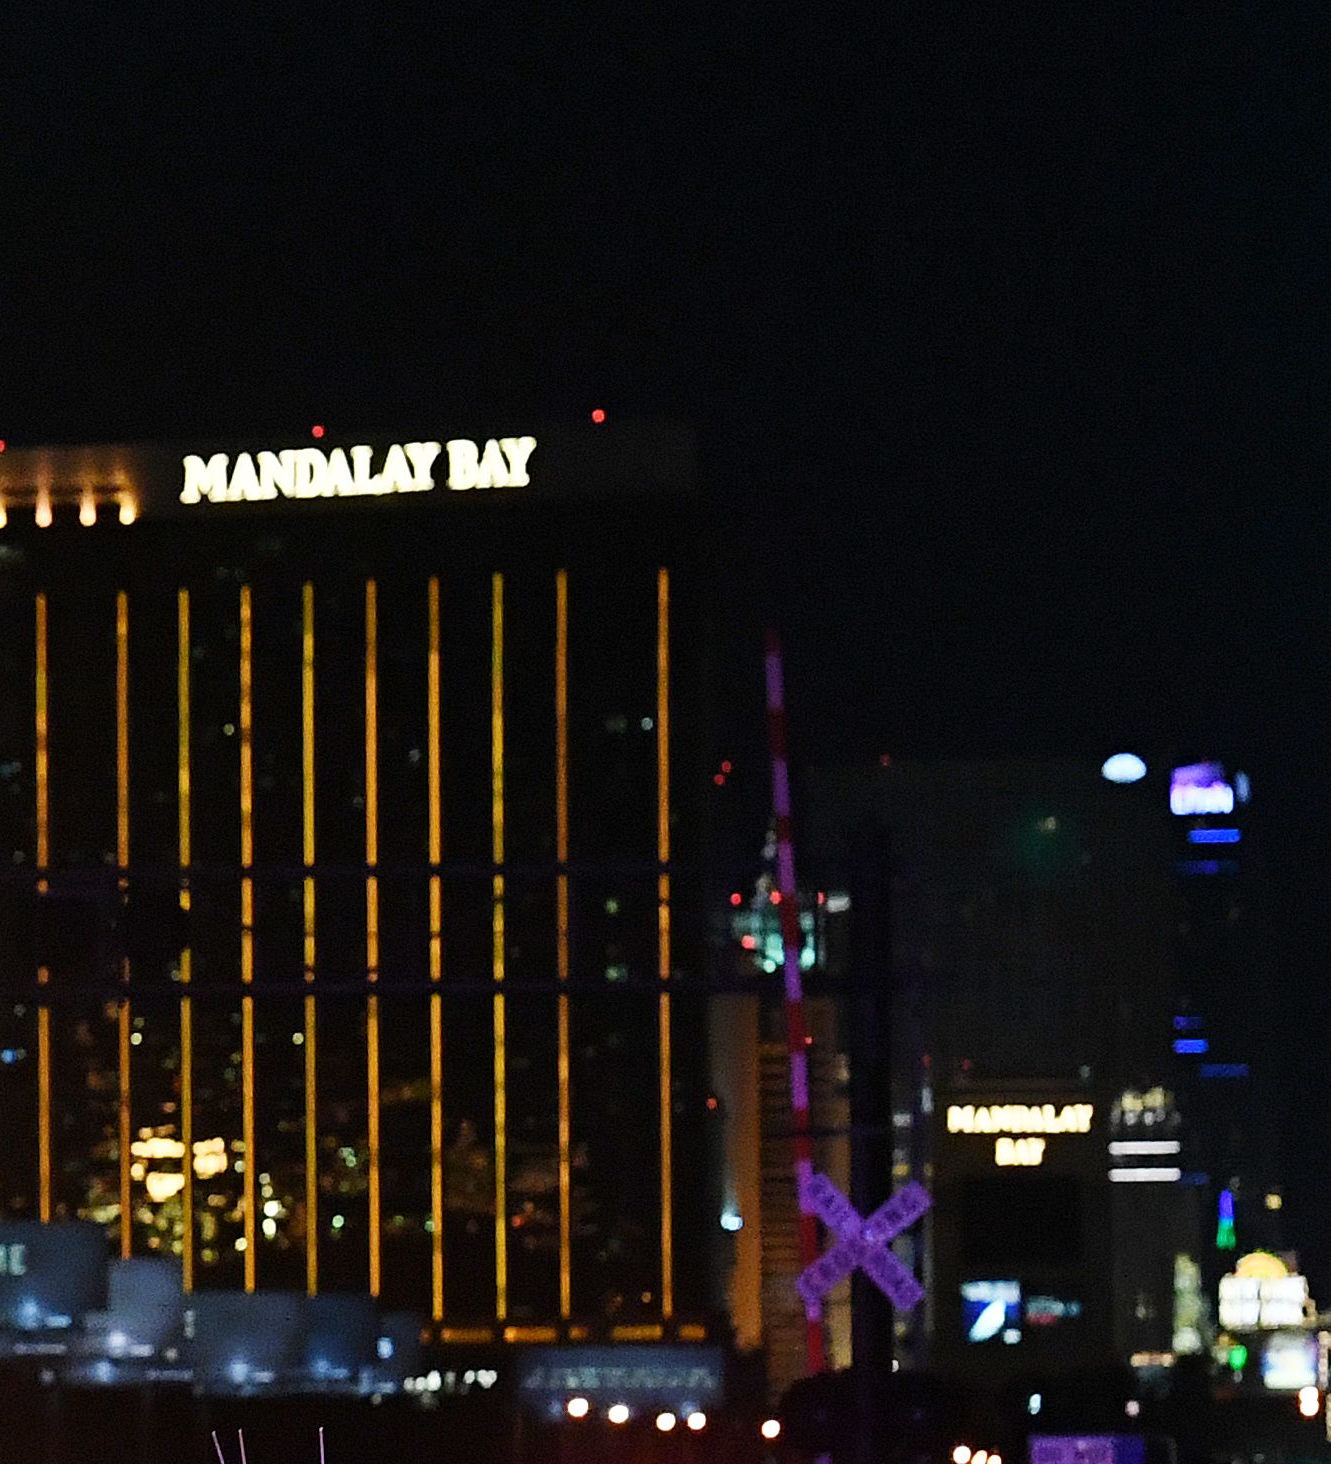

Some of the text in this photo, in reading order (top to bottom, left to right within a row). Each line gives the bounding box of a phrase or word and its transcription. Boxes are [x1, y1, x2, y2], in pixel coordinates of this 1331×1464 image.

[180, 436, 537, 504] MANDALAY BAY
[947, 1104, 1093, 1134] MANDALAY
